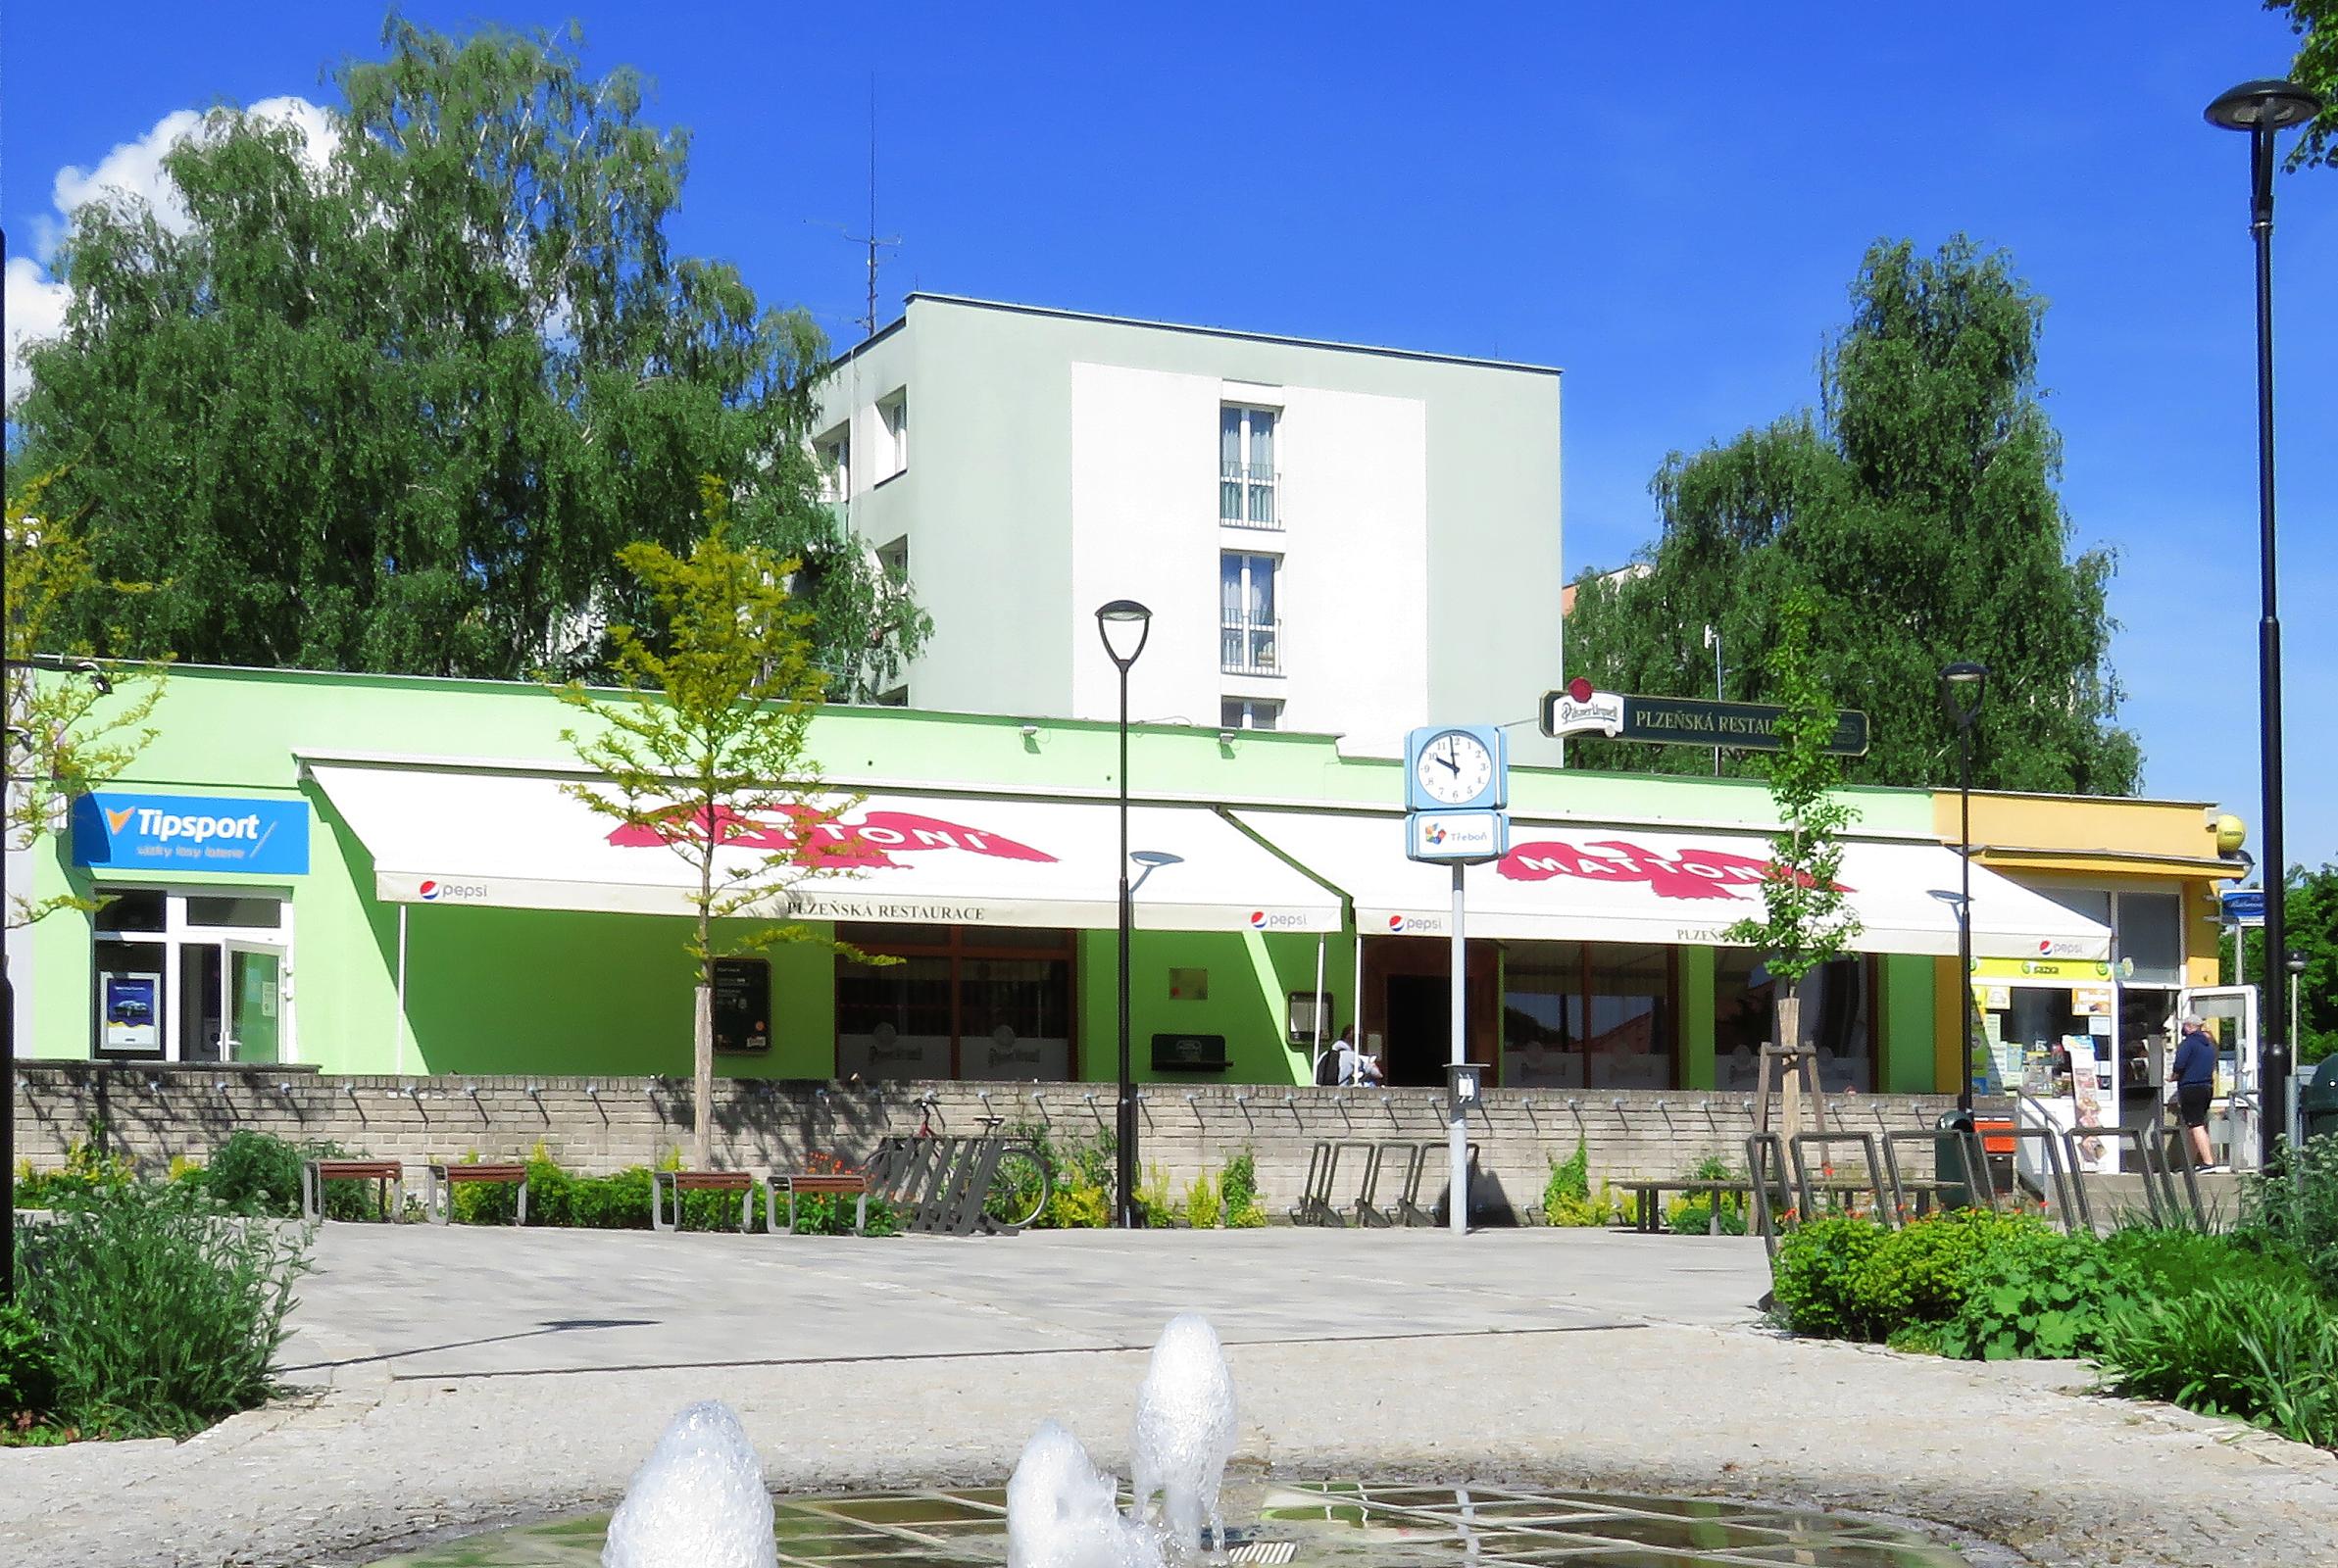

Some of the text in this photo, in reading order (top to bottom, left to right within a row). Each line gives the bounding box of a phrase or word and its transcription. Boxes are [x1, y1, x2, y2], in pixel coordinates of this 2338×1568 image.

[1636, 710, 1776, 735] PLZEŇSKÁ RESTAU
[136, 808, 261, 843] Tipsport
[1517, 855, 1770, 881] MATTON
[442, 884, 487, 899] pepsi
[787, 900, 985, 920] PLZEŇSKÁ RESTAURACE
[1269, 913, 1308, 929] pepsi
[1406, 917, 1442, 931] pepsi
